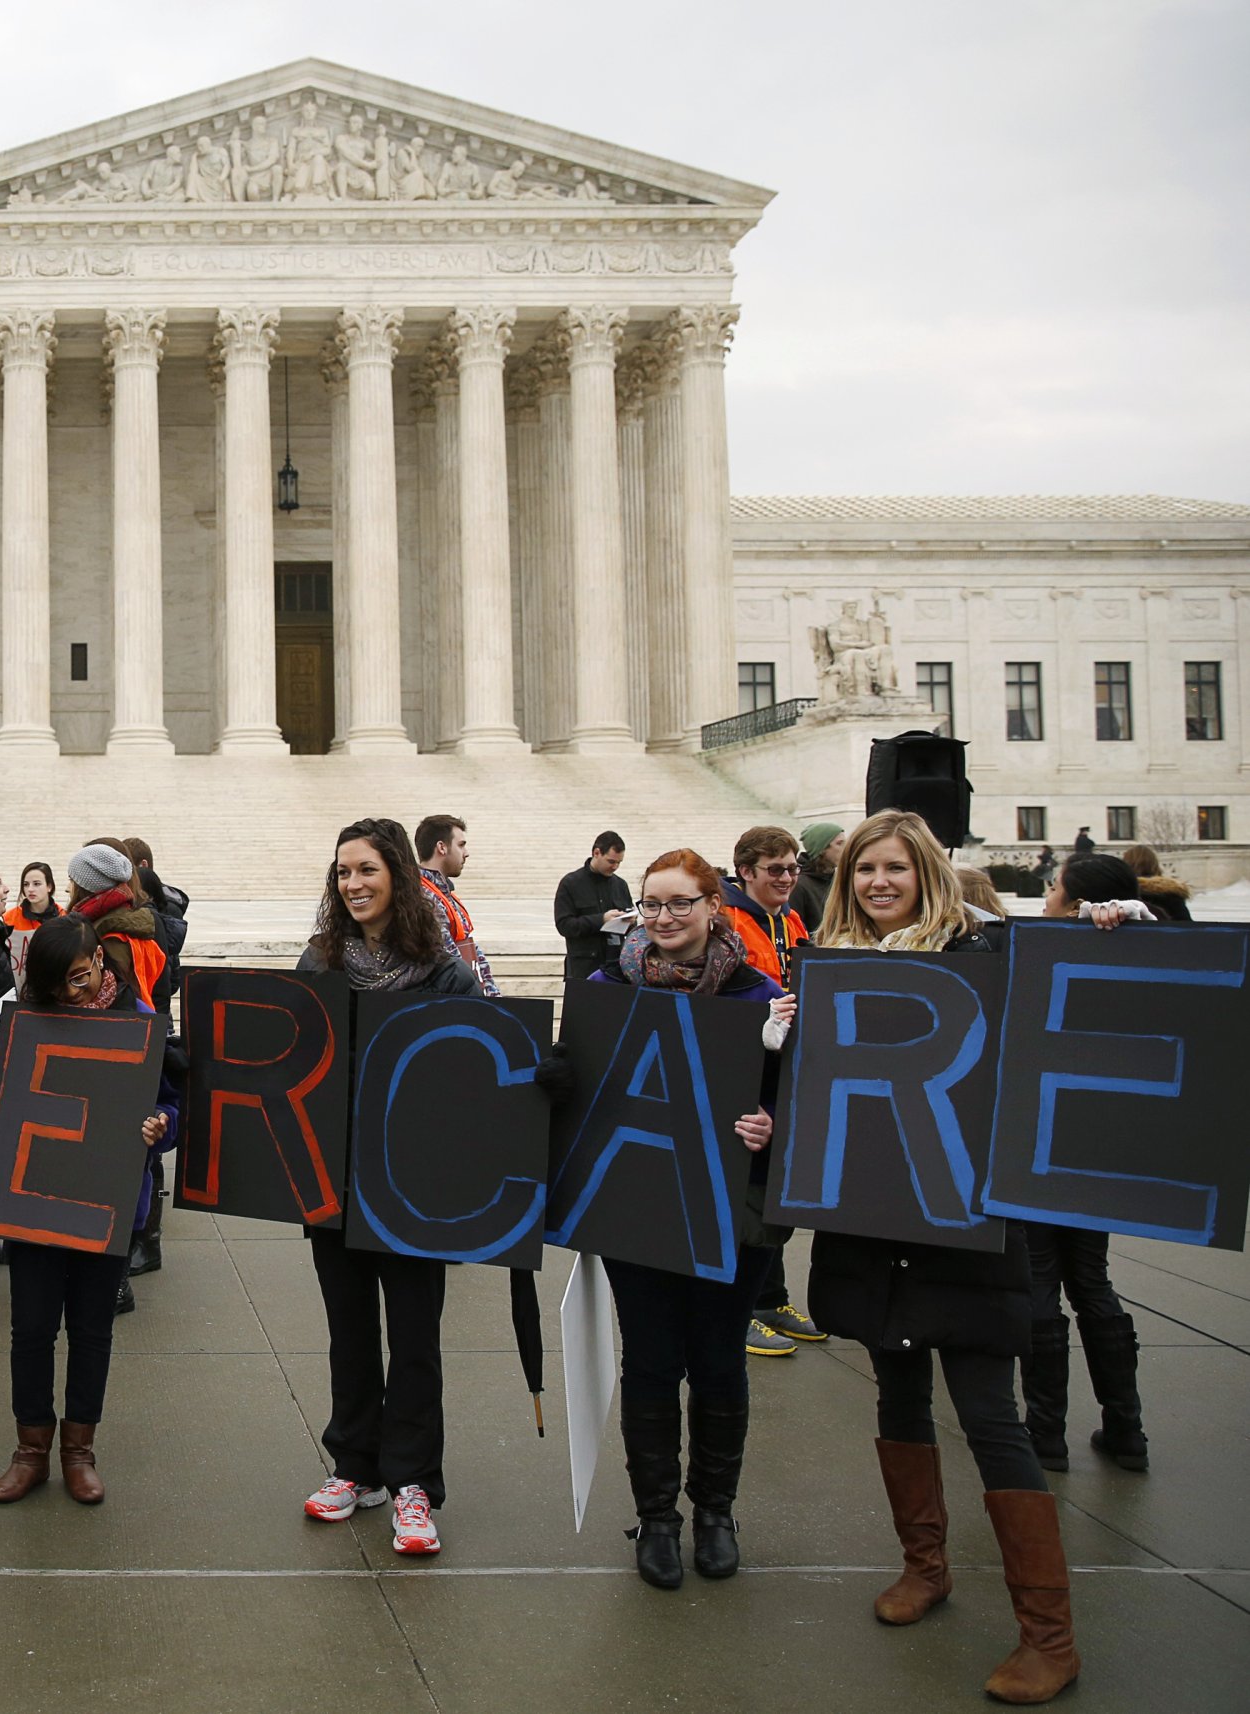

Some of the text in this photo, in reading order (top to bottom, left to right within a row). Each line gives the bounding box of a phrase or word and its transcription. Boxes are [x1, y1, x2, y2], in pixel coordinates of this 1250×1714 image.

[151, 251, 469, 272] EQUAL JUSTICE UNDER LAW
